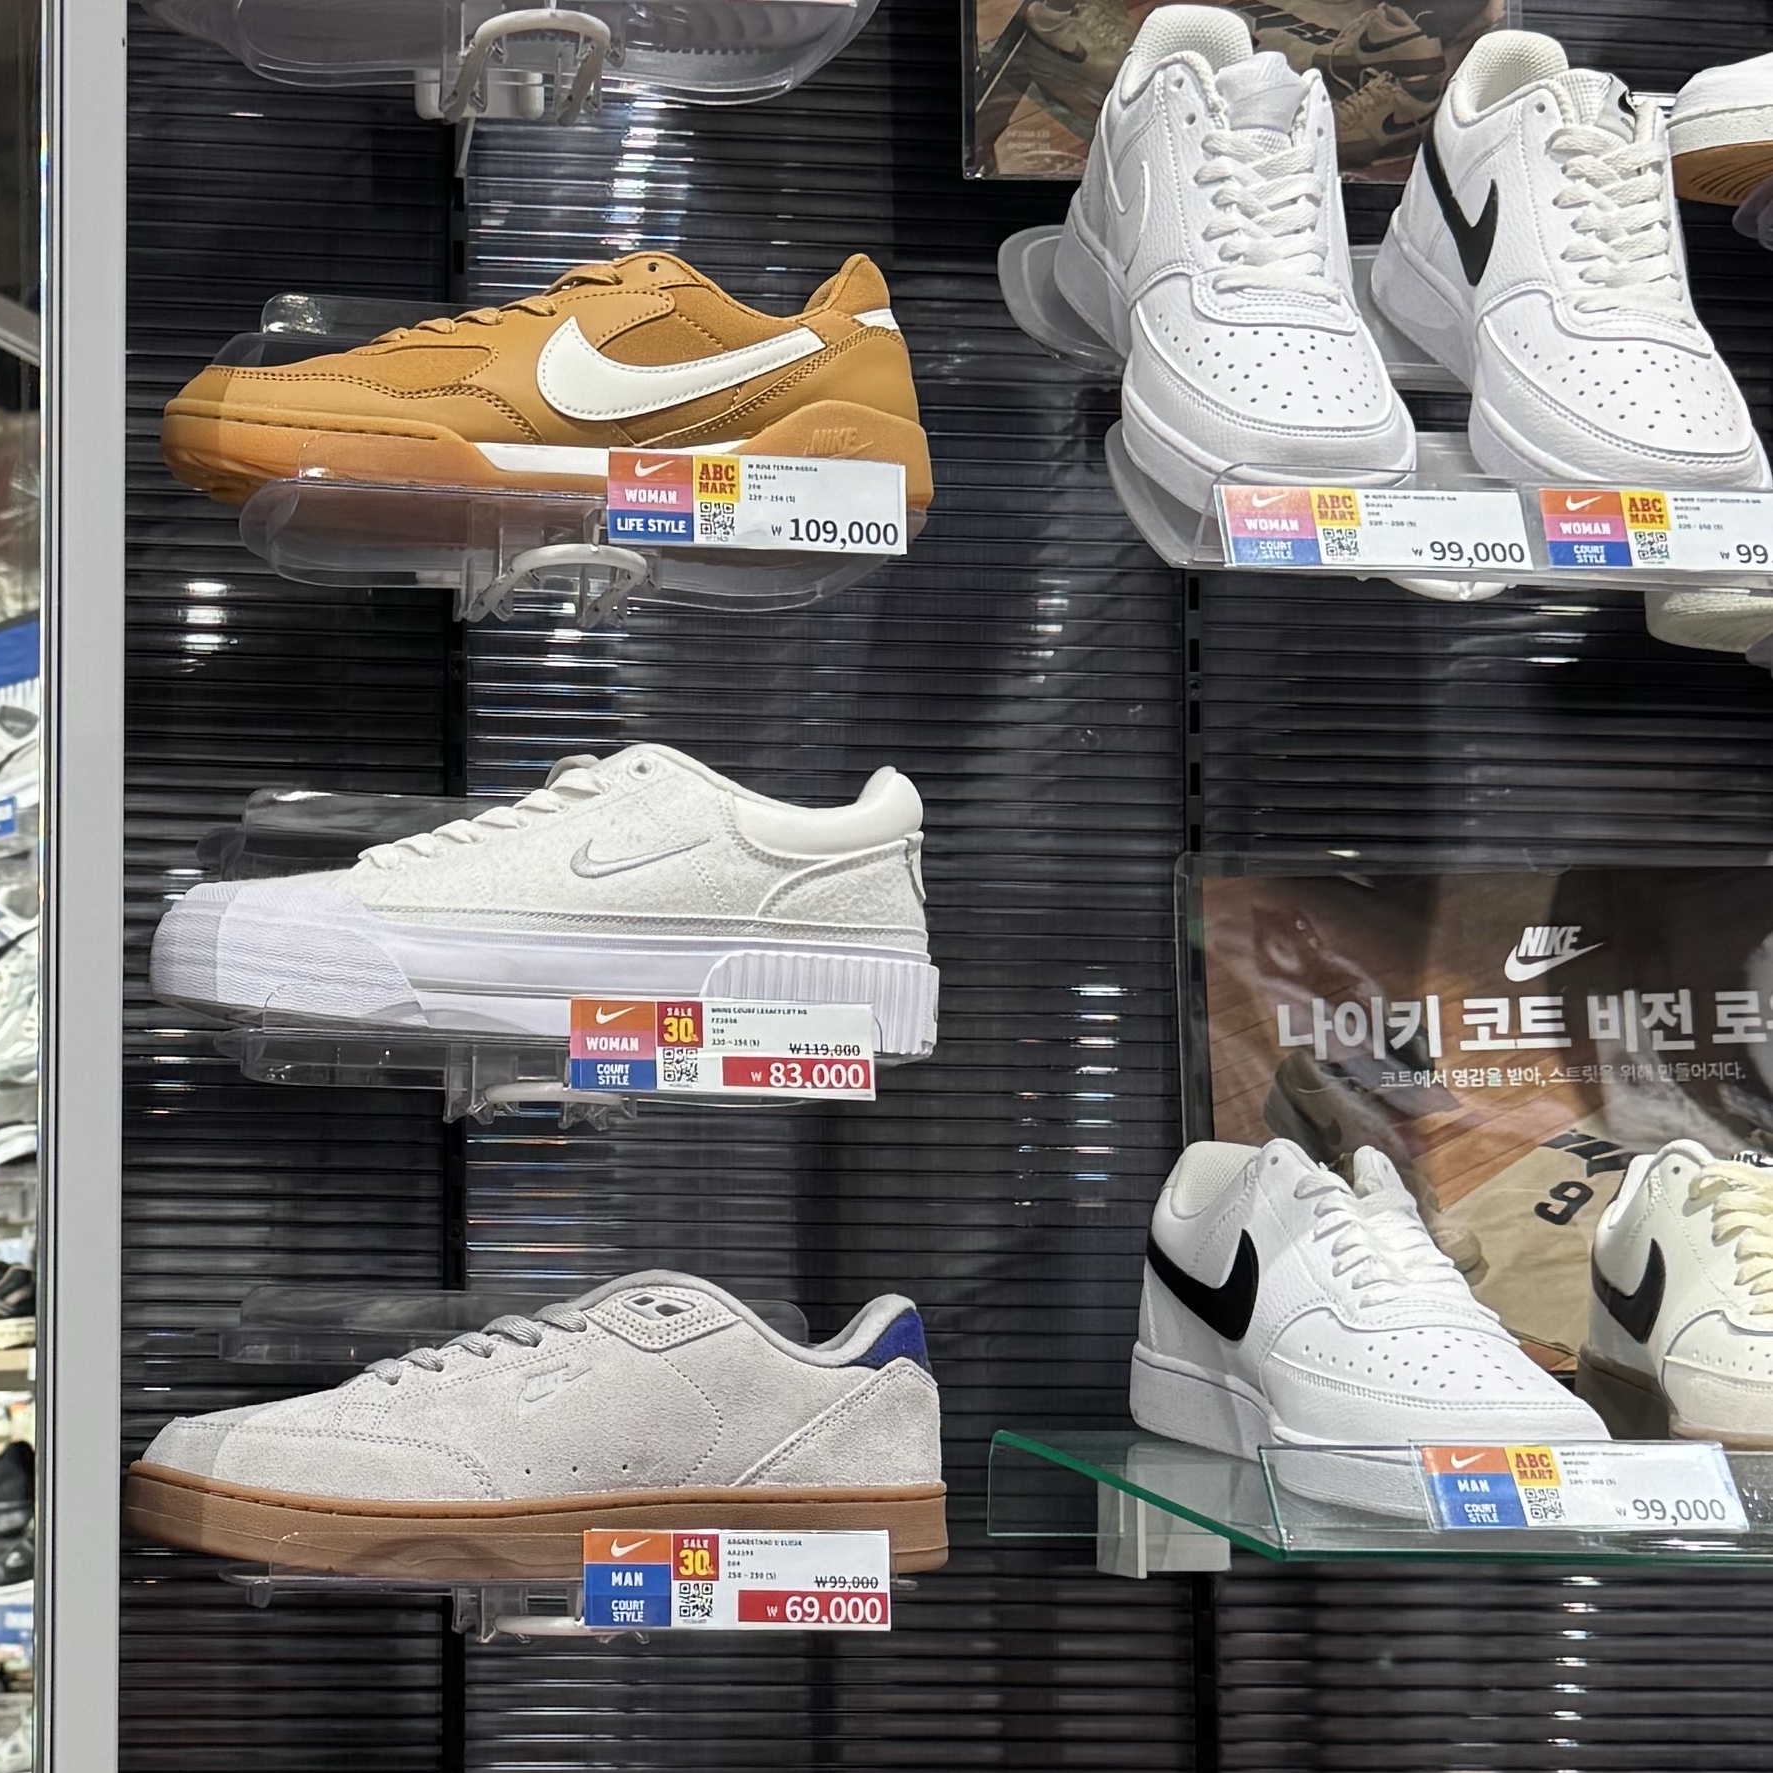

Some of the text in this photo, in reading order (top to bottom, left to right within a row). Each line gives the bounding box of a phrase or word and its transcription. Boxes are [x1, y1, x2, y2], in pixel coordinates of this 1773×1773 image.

[699, 463, 735, 481] ABC
[625, 488, 677, 504] WOMAN
[698, 481, 737, 496] MART
[1317, 494, 1353, 509] ABC
[1628, 497, 1662, 513] ABC
[1317, 509, 1356, 521] MART
[1629, 513, 1664, 525] MART
[617, 517, 686, 534] LIFE STYLE
[1244, 518, 1299, 532] WOMAN
[1559, 522, 1611, 535] WOMAN
[789, 517, 899, 549] 109,000
[1259, 541, 1292, 551] COURT
[1574, 544, 1605, 554] COURT
[1429, 541, 1525, 567] 99,000
[1517, 926, 1581, 957] NIKE
[666, 1007, 692, 1016] SALE
[1277, 996, 1442, 1060] 나이키
[1459, 996, 1572, 1050] 코트
[1587, 989, 1696, 1052] 비전
[586, 1036, 639, 1051] WOMAN
[597, 1063, 630, 1075] COURT
[769, 1063, 864, 1089] 83,000
[598, 1075, 629, 1086] STYLE
[1380, 1070, 1447, 1088] 코트에서
[1452, 1069, 1503, 1087] 영감을
[1507, 1067, 1546, 1086] 받아,
[1534, 1181, 1594, 1225] 9
[1515, 1454, 1550, 1469] ABC
[1517, 1469, 1554, 1481] MART
[1457, 1480, 1490, 1493] MAN
[1464, 1504, 1497, 1514] COURT
[1632, 1499, 1726, 1526] 99,000
[683, 1539, 709, 1549] SALE
[611, 1572, 644, 1587] MAN
[611, 1599, 645, 1611] COURT
[784, 1596, 882, 1624] 69,000
[612, 1611, 645, 1623] STYLE
